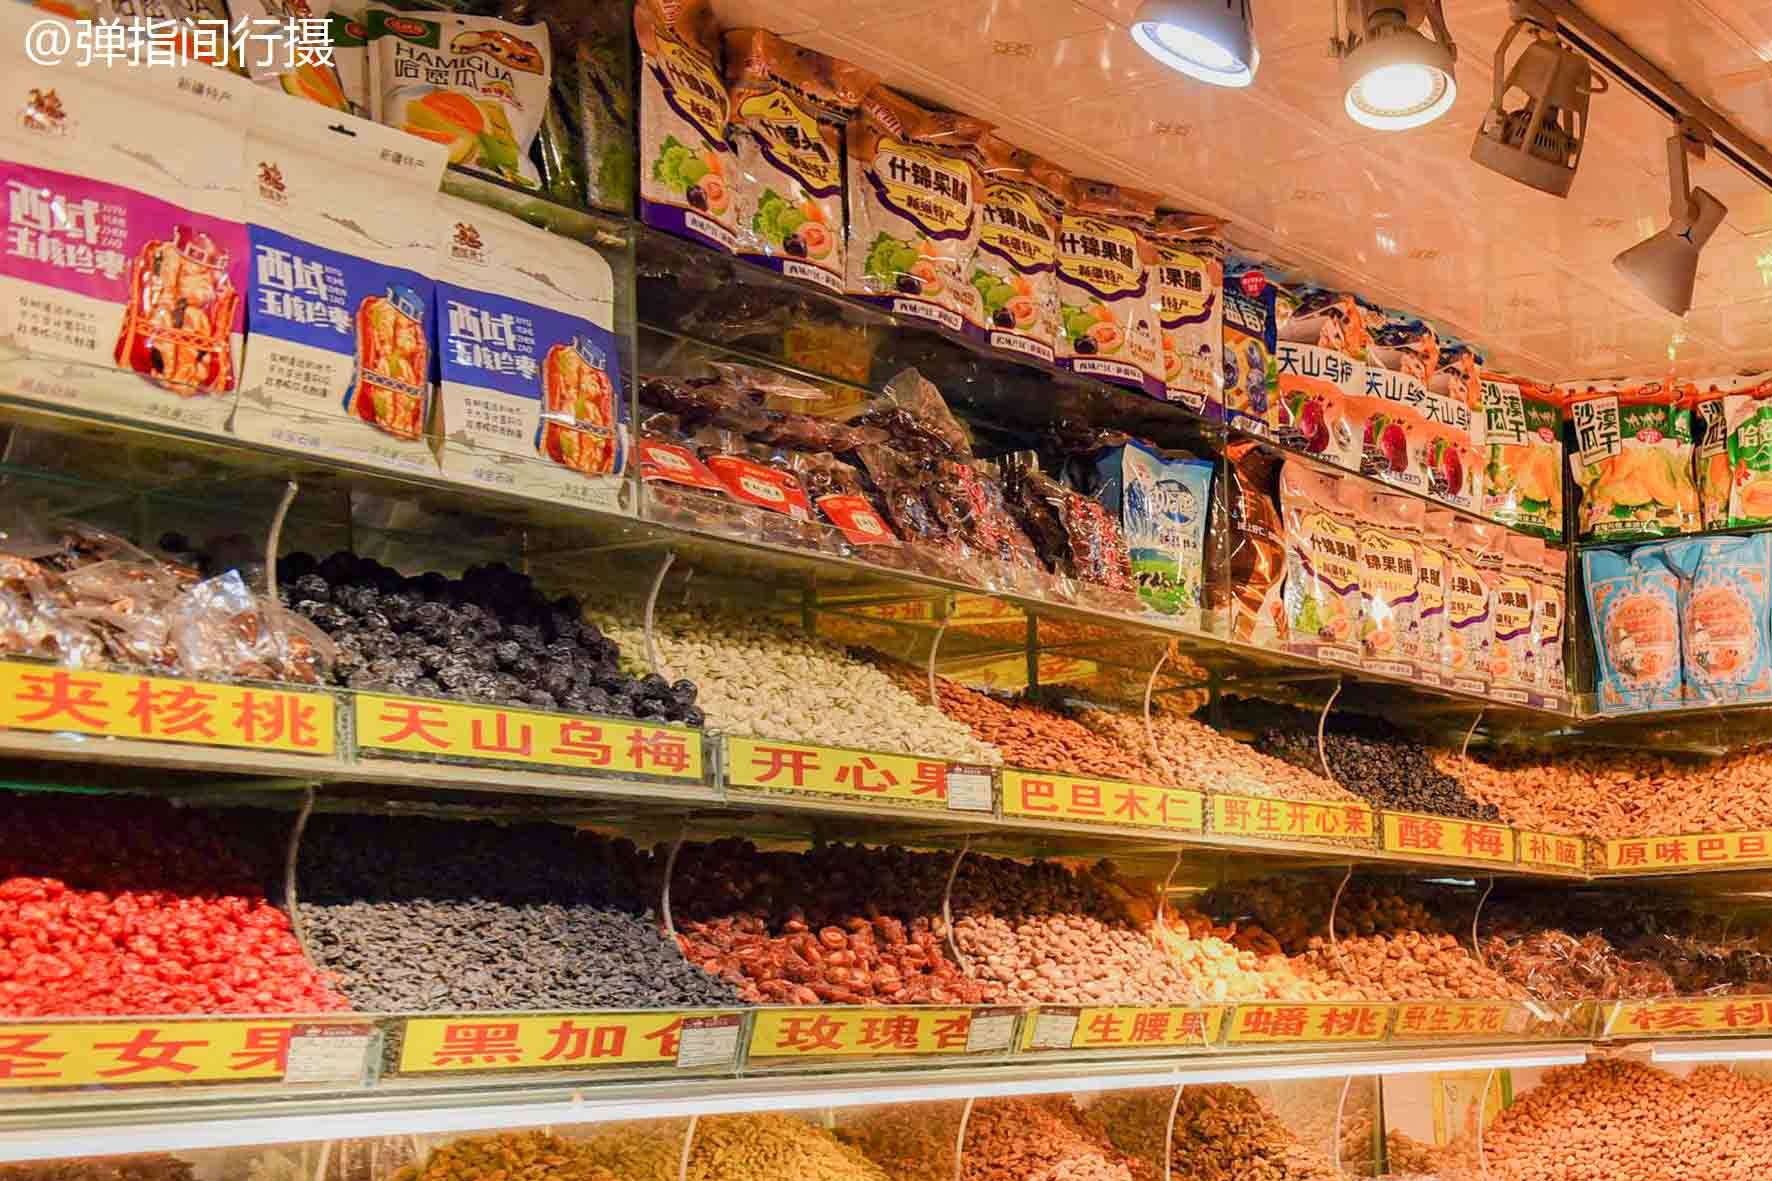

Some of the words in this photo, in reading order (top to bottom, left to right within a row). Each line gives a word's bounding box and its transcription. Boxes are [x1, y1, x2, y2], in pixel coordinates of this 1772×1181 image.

[395, 59, 479, 91] 哈密瓜
[396, 42, 514, 88] HAMIGUA
[1060, 232, 1134, 270] 什锦果脯
[256, 245, 327, 300] 西域
[1160, 267, 1202, 292] 果脯
[447, 300, 517, 351] 西域
[1362, 553, 1414, 577] 锦果脯
[1451, 576, 1483, 597] 果脯
[1499, 591, 1528, 610] 果脯
[16, 671, 320, 748] 夹核桃
[379, 701, 692, 774] 天山乌梅
[1021, 778, 1190, 823] 巴旦木仁
[1224, 799, 1369, 835] 野生开心果
[1399, 816, 1504, 857] 酸梅
[1087, 1009, 1218, 1044] 生腰果
[1242, 1006, 1383, 1037] 蟠桃
[1405, 1006, 1500, 1032] 野生无花
